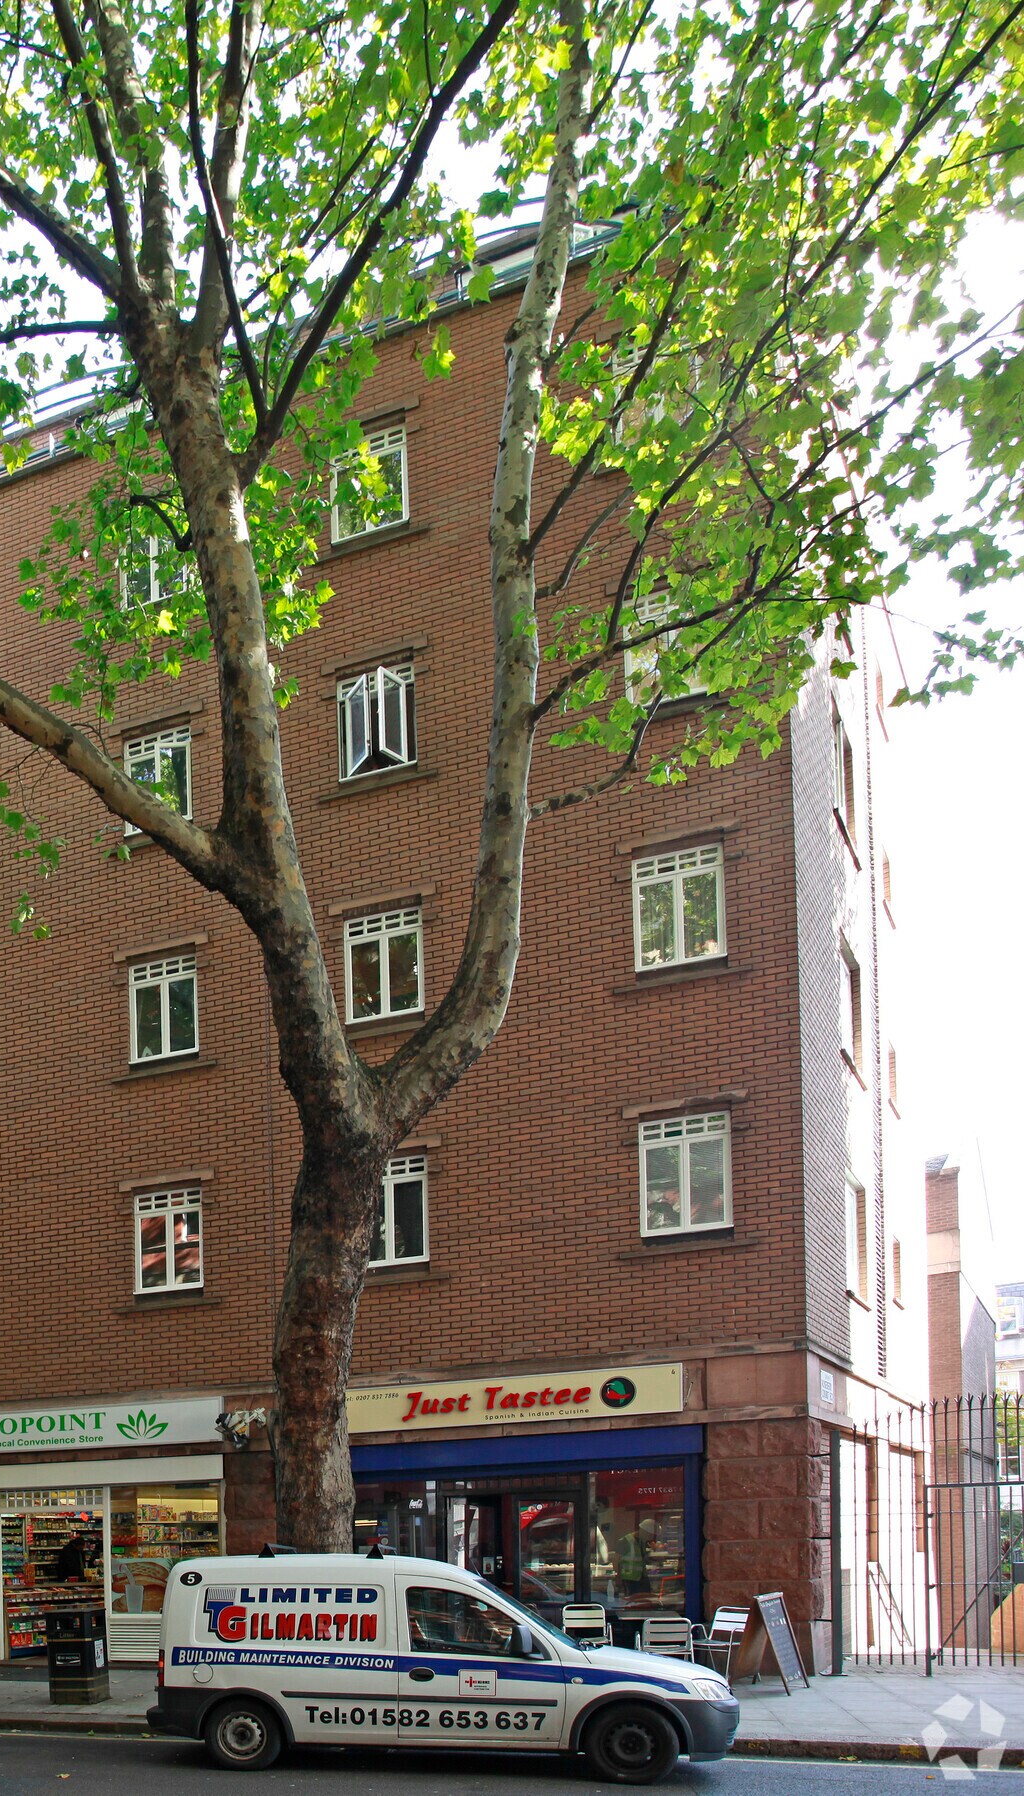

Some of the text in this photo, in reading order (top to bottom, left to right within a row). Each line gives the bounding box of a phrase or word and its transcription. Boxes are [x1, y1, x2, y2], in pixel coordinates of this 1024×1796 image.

[402, 1385, 592, 1422] Just Tastee
[485, 1412, 516, 1420] Spanish
[17, 1436, 77, 1447] Convenience
[78, 1434, 104, 1443] Store
[186, 1573, 196, 1584] 5
[240, 1587, 378, 1603] LIMITED
[178, 1649, 395, 1669] BUILDING MAINTENANCE DIVISION
[305, 1706, 546, 1731] Tel:01582 653 637
